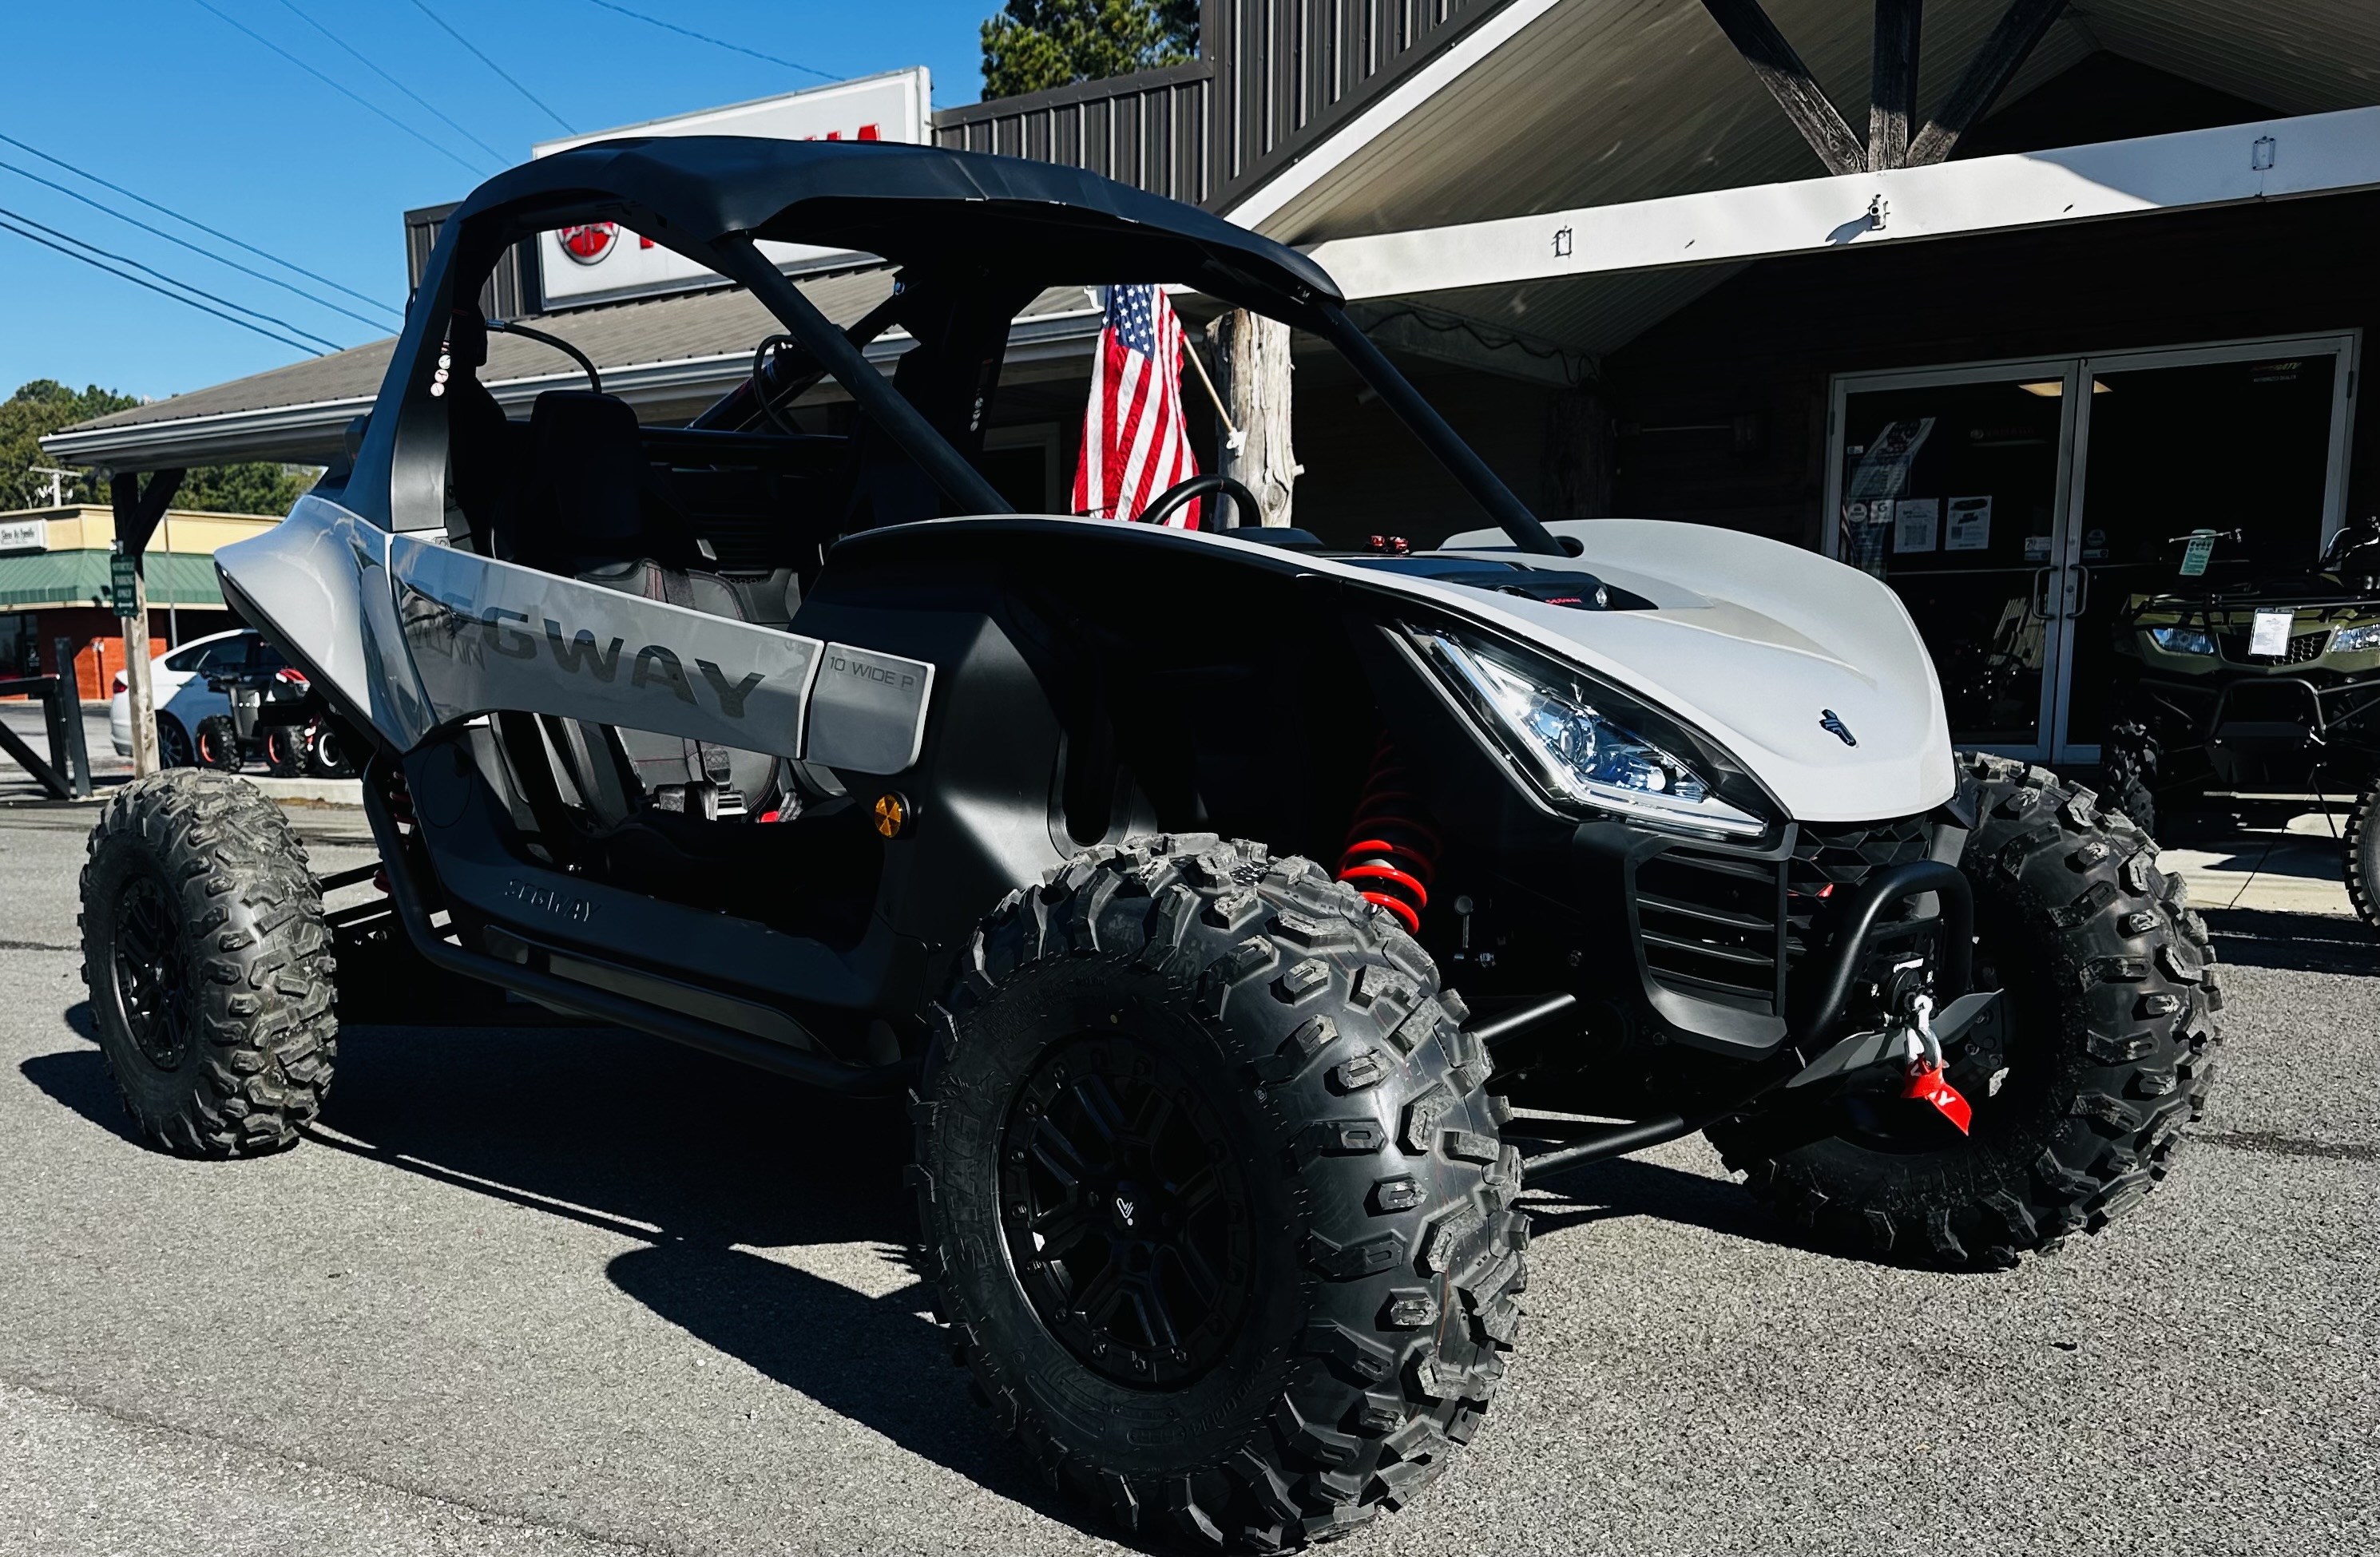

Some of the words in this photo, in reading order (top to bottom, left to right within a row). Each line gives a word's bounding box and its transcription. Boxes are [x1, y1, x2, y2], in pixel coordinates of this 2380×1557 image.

[830, 656, 846, 672] 10
[852, 661, 896, 685] WIDE
[902, 675, 914, 688] P
[504, 878, 601, 922] SEGWAY
